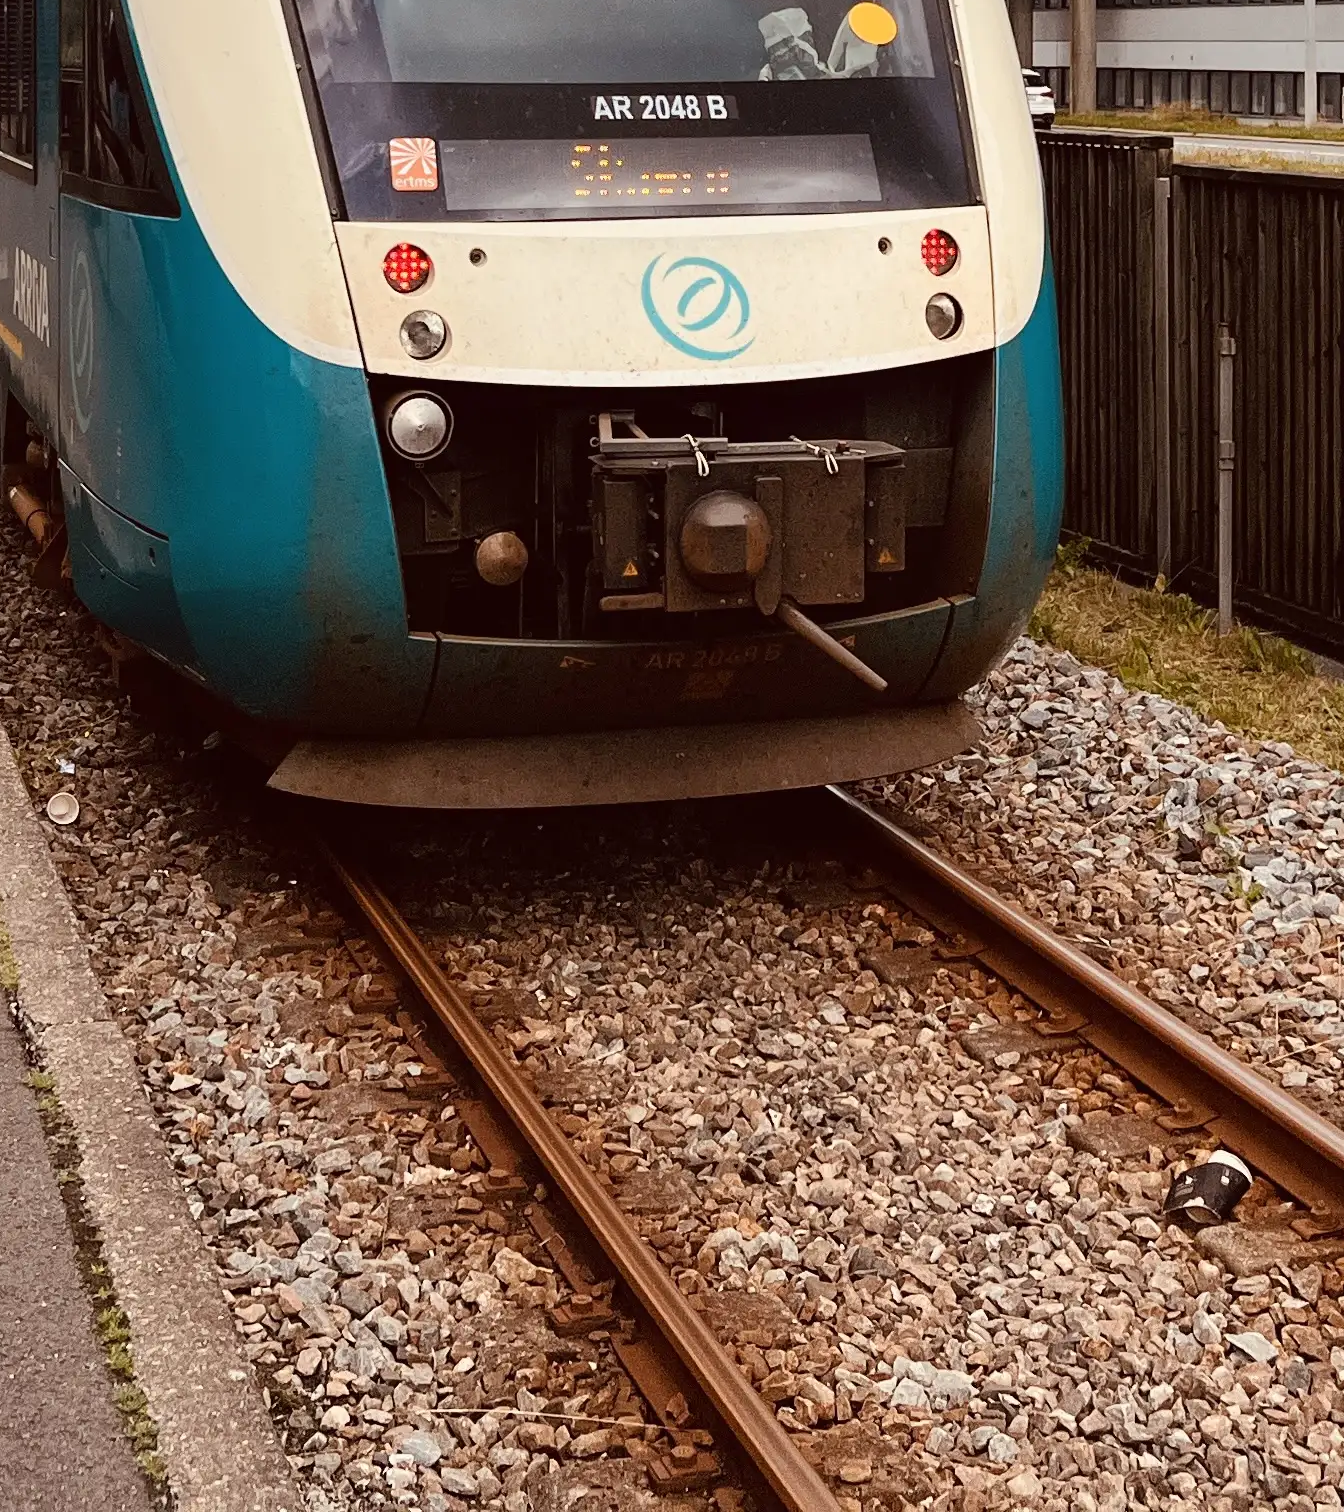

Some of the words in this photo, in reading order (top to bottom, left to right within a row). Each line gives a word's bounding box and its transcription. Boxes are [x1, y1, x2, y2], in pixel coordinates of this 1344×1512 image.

[594, 95, 634, 120] AR
[639, 94, 701, 120] 2048
[706, 94, 728, 120] B
[395, 176, 435, 188] ertms
[13, 246, 50, 348] ARRIVA
